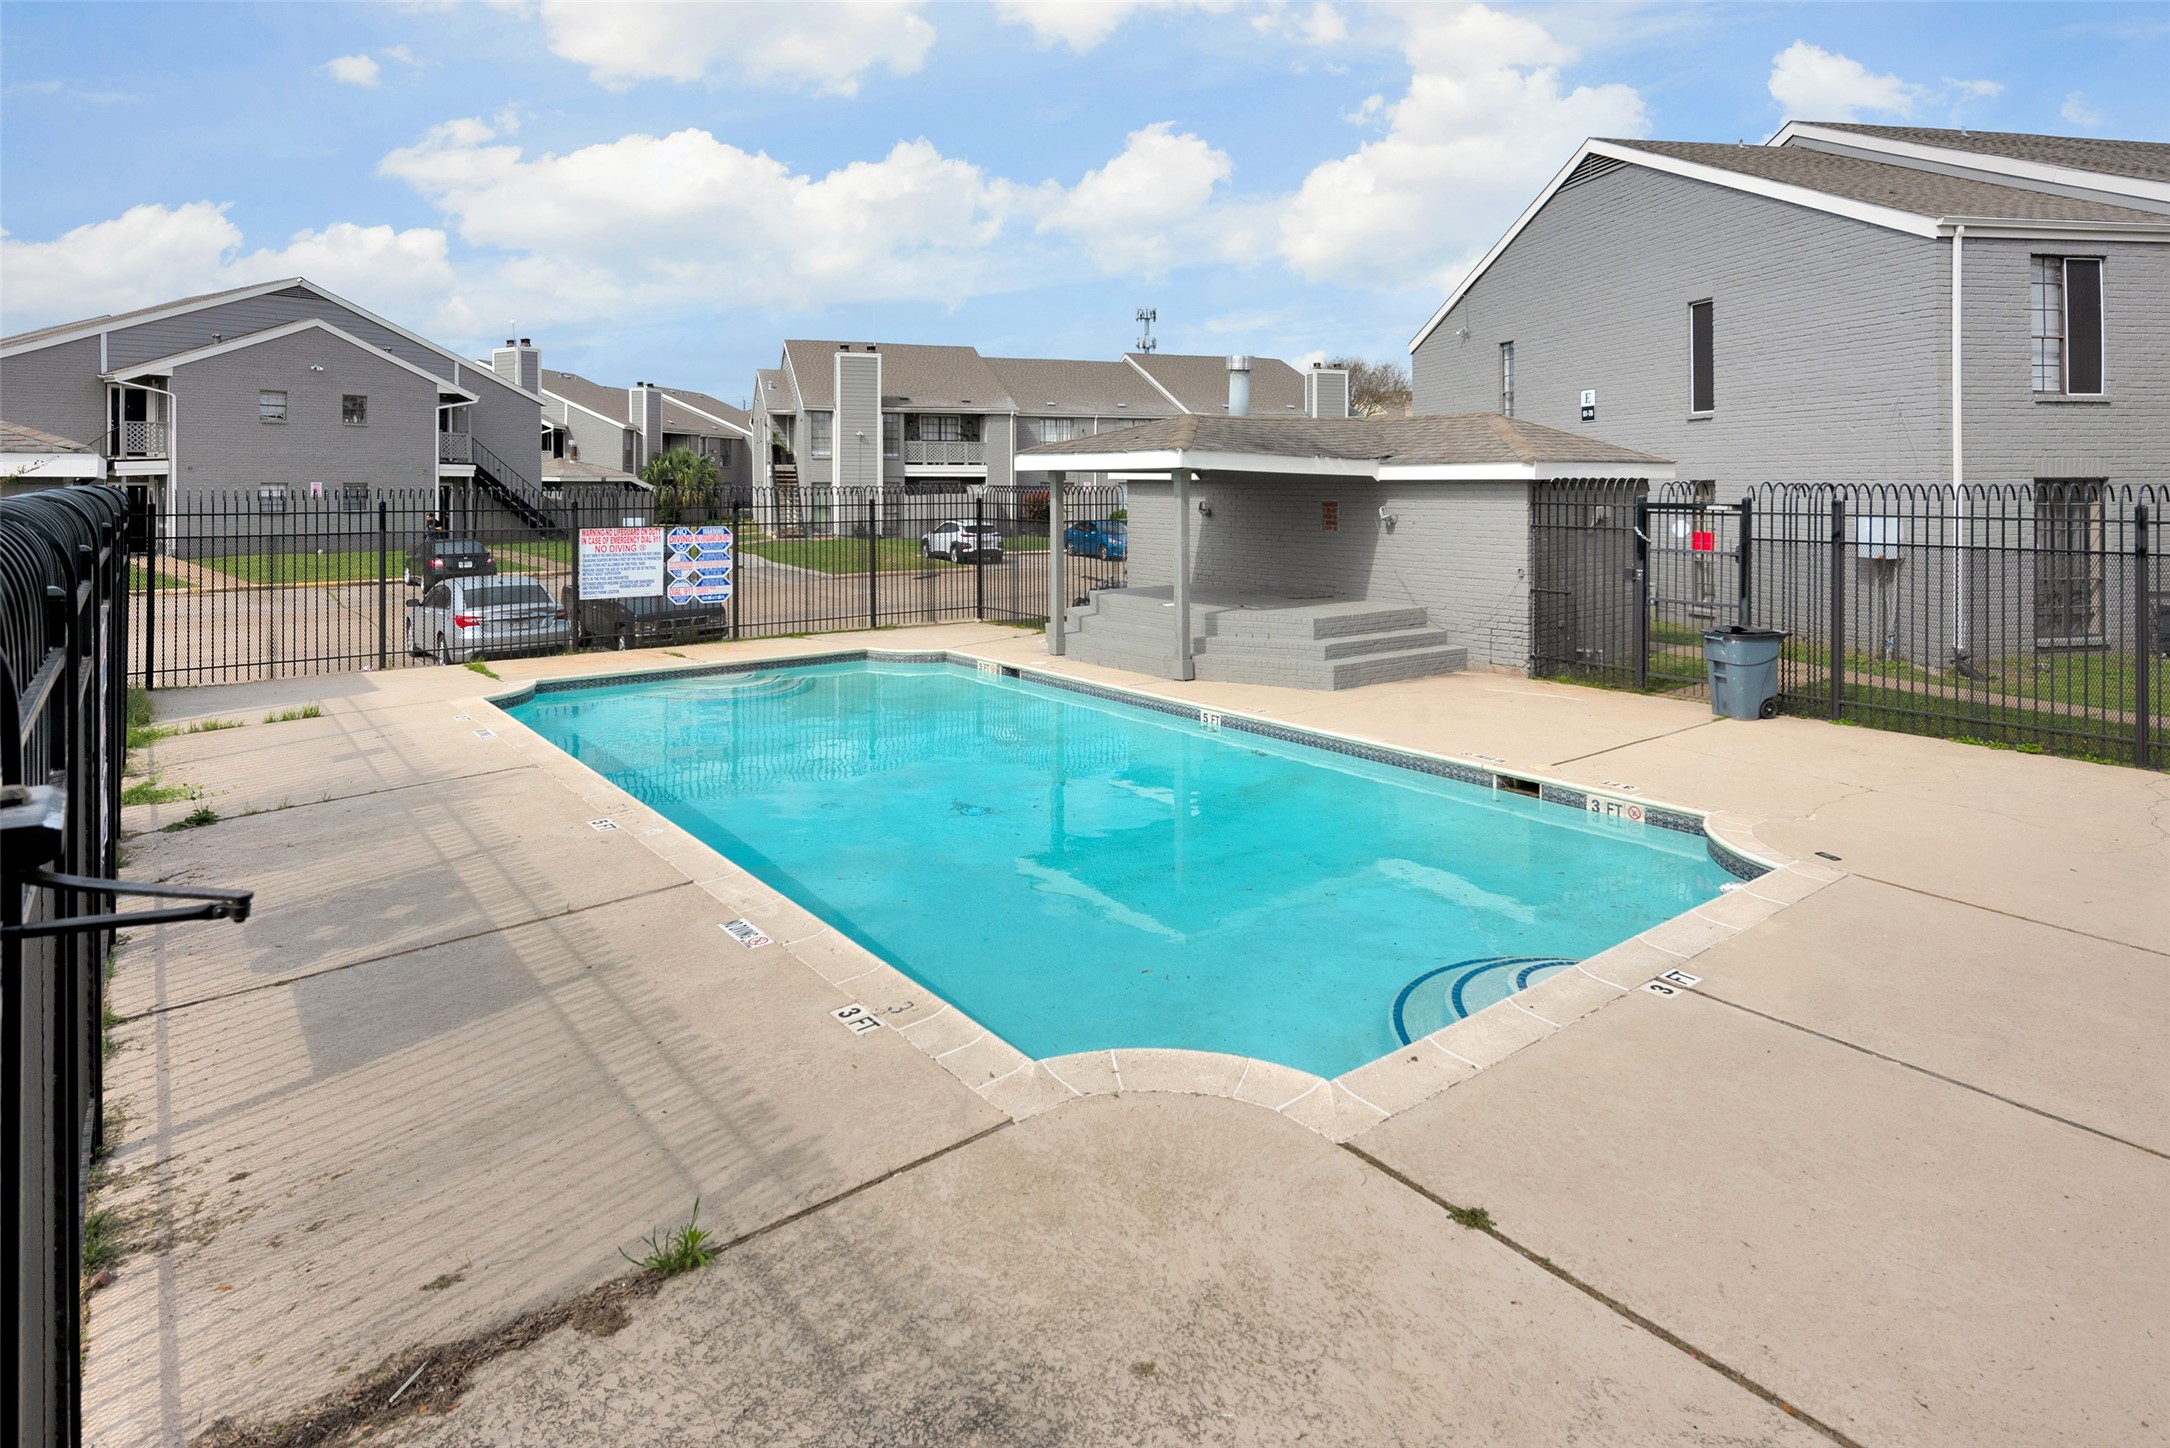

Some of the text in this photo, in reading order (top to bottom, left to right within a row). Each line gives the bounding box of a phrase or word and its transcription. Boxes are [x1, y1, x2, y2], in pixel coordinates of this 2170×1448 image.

[1585, 393, 1592, 404] E
[1203, 713, 1220, 725] 5 FT
[1592, 799, 1622, 817] 3 FT
[1650, 971, 1696, 995] 3 FT
[838, 1007, 880, 1032] 3 FT
